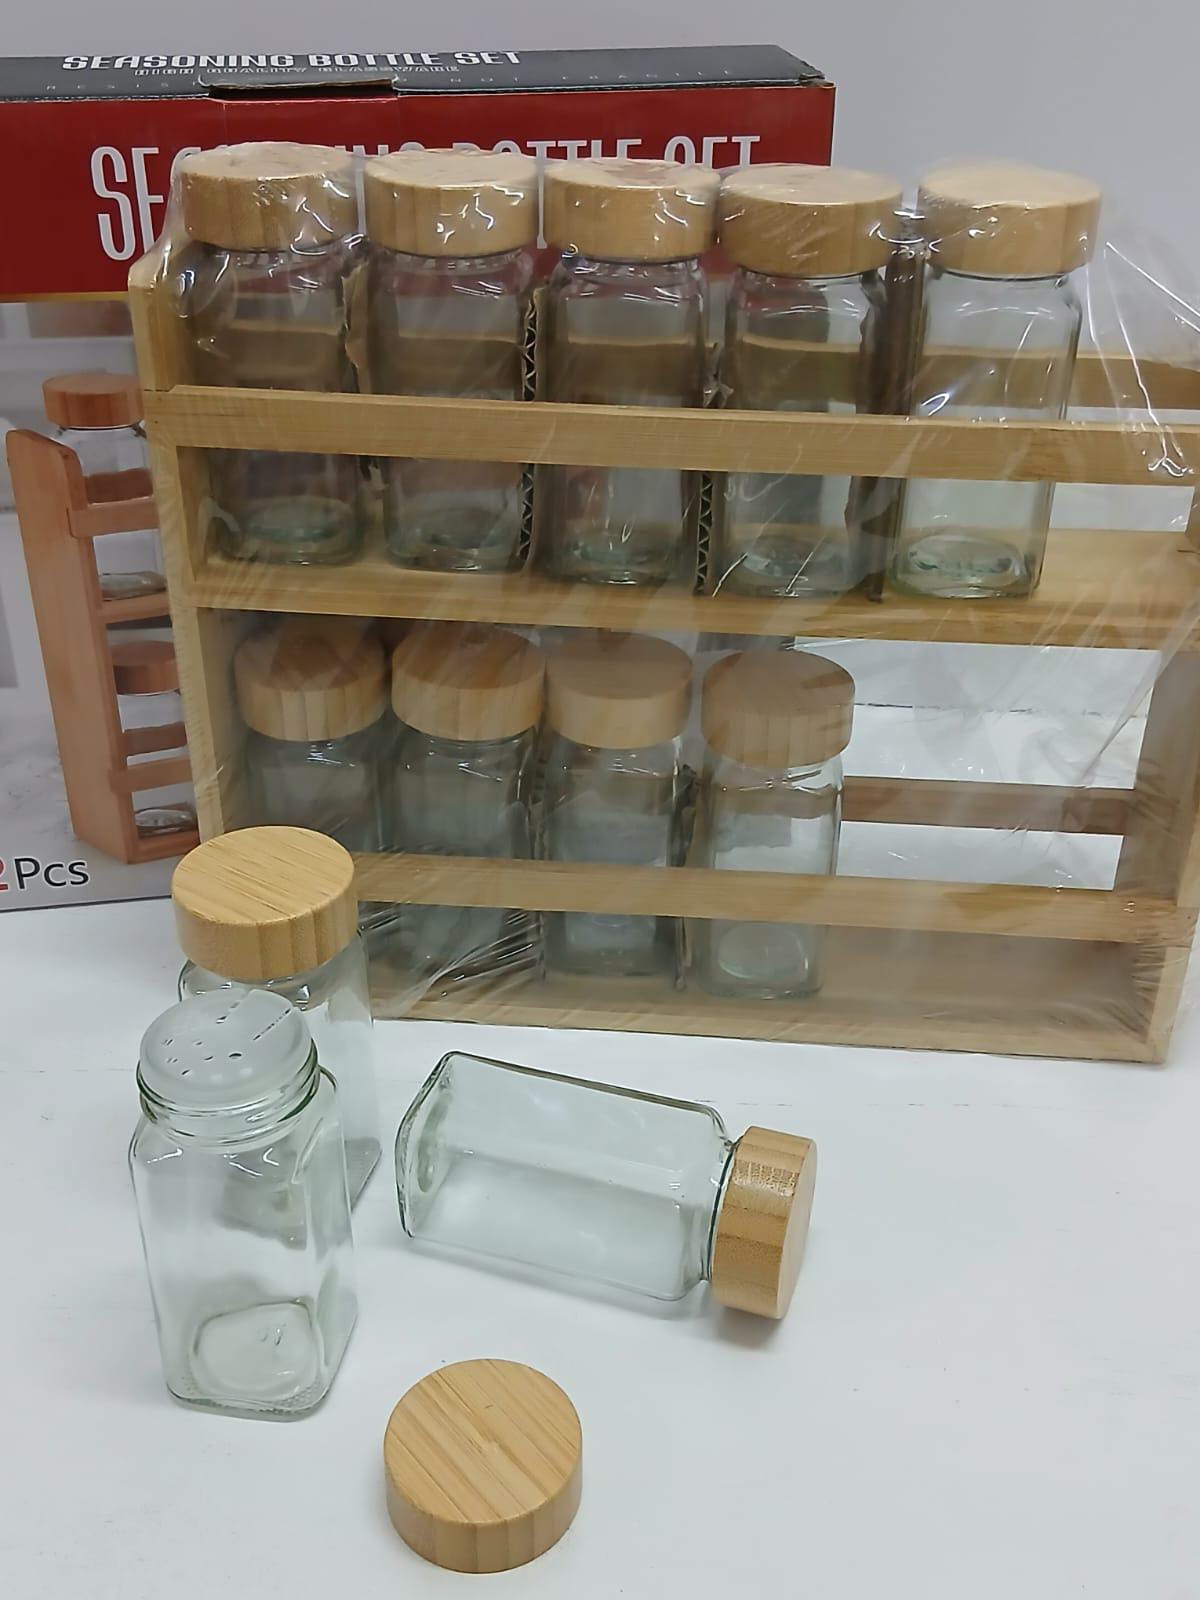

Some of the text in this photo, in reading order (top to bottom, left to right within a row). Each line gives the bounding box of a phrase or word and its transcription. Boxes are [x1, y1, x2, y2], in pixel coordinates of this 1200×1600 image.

[62, 50, 522, 70] SEASONING BOTTLE SET
